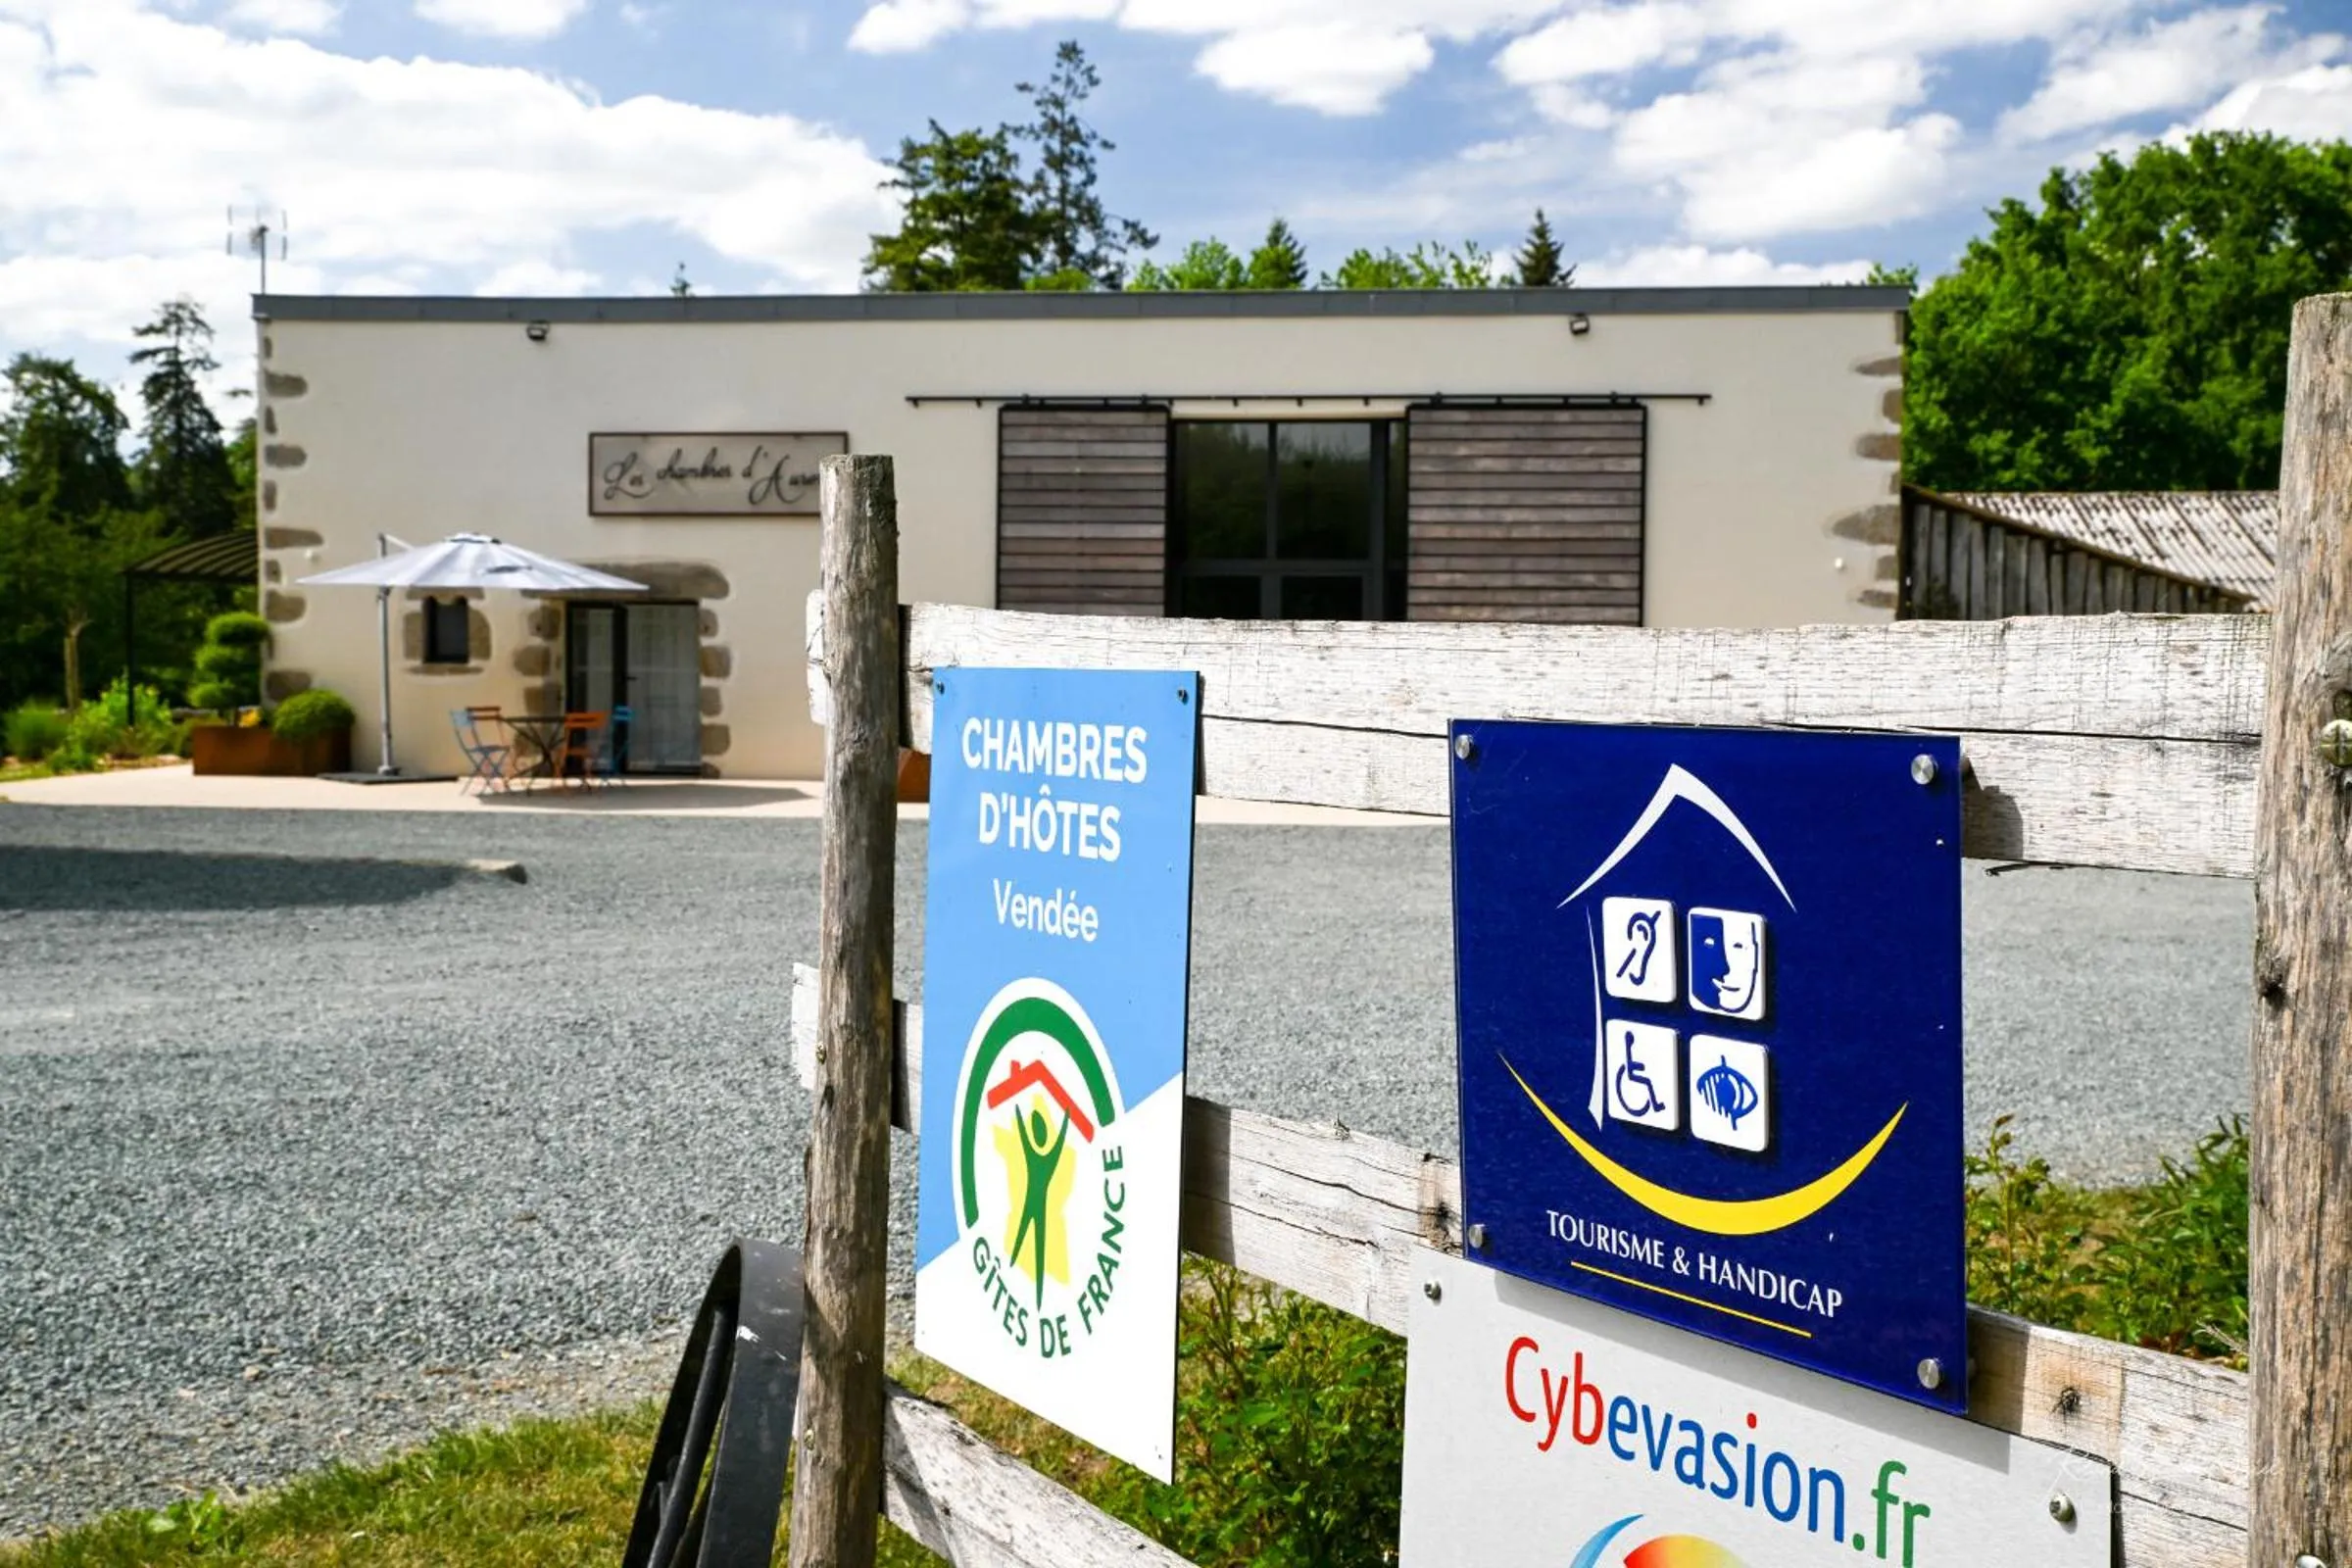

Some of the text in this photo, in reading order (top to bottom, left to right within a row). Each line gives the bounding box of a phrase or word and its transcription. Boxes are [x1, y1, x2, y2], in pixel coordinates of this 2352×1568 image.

[961, 716, 1148, 784] CHAMBRES
[978, 783, 1121, 862] D'HÔTES
[992, 877, 1099, 942] Vendée
[972, 1145, 1126, 1359] GÎTES DE FRANCE
[1545, 1209, 1843, 1319] TOURISME & HANDICAP
[1503, 1335, 1932, 1568] Cybevasion.fr
